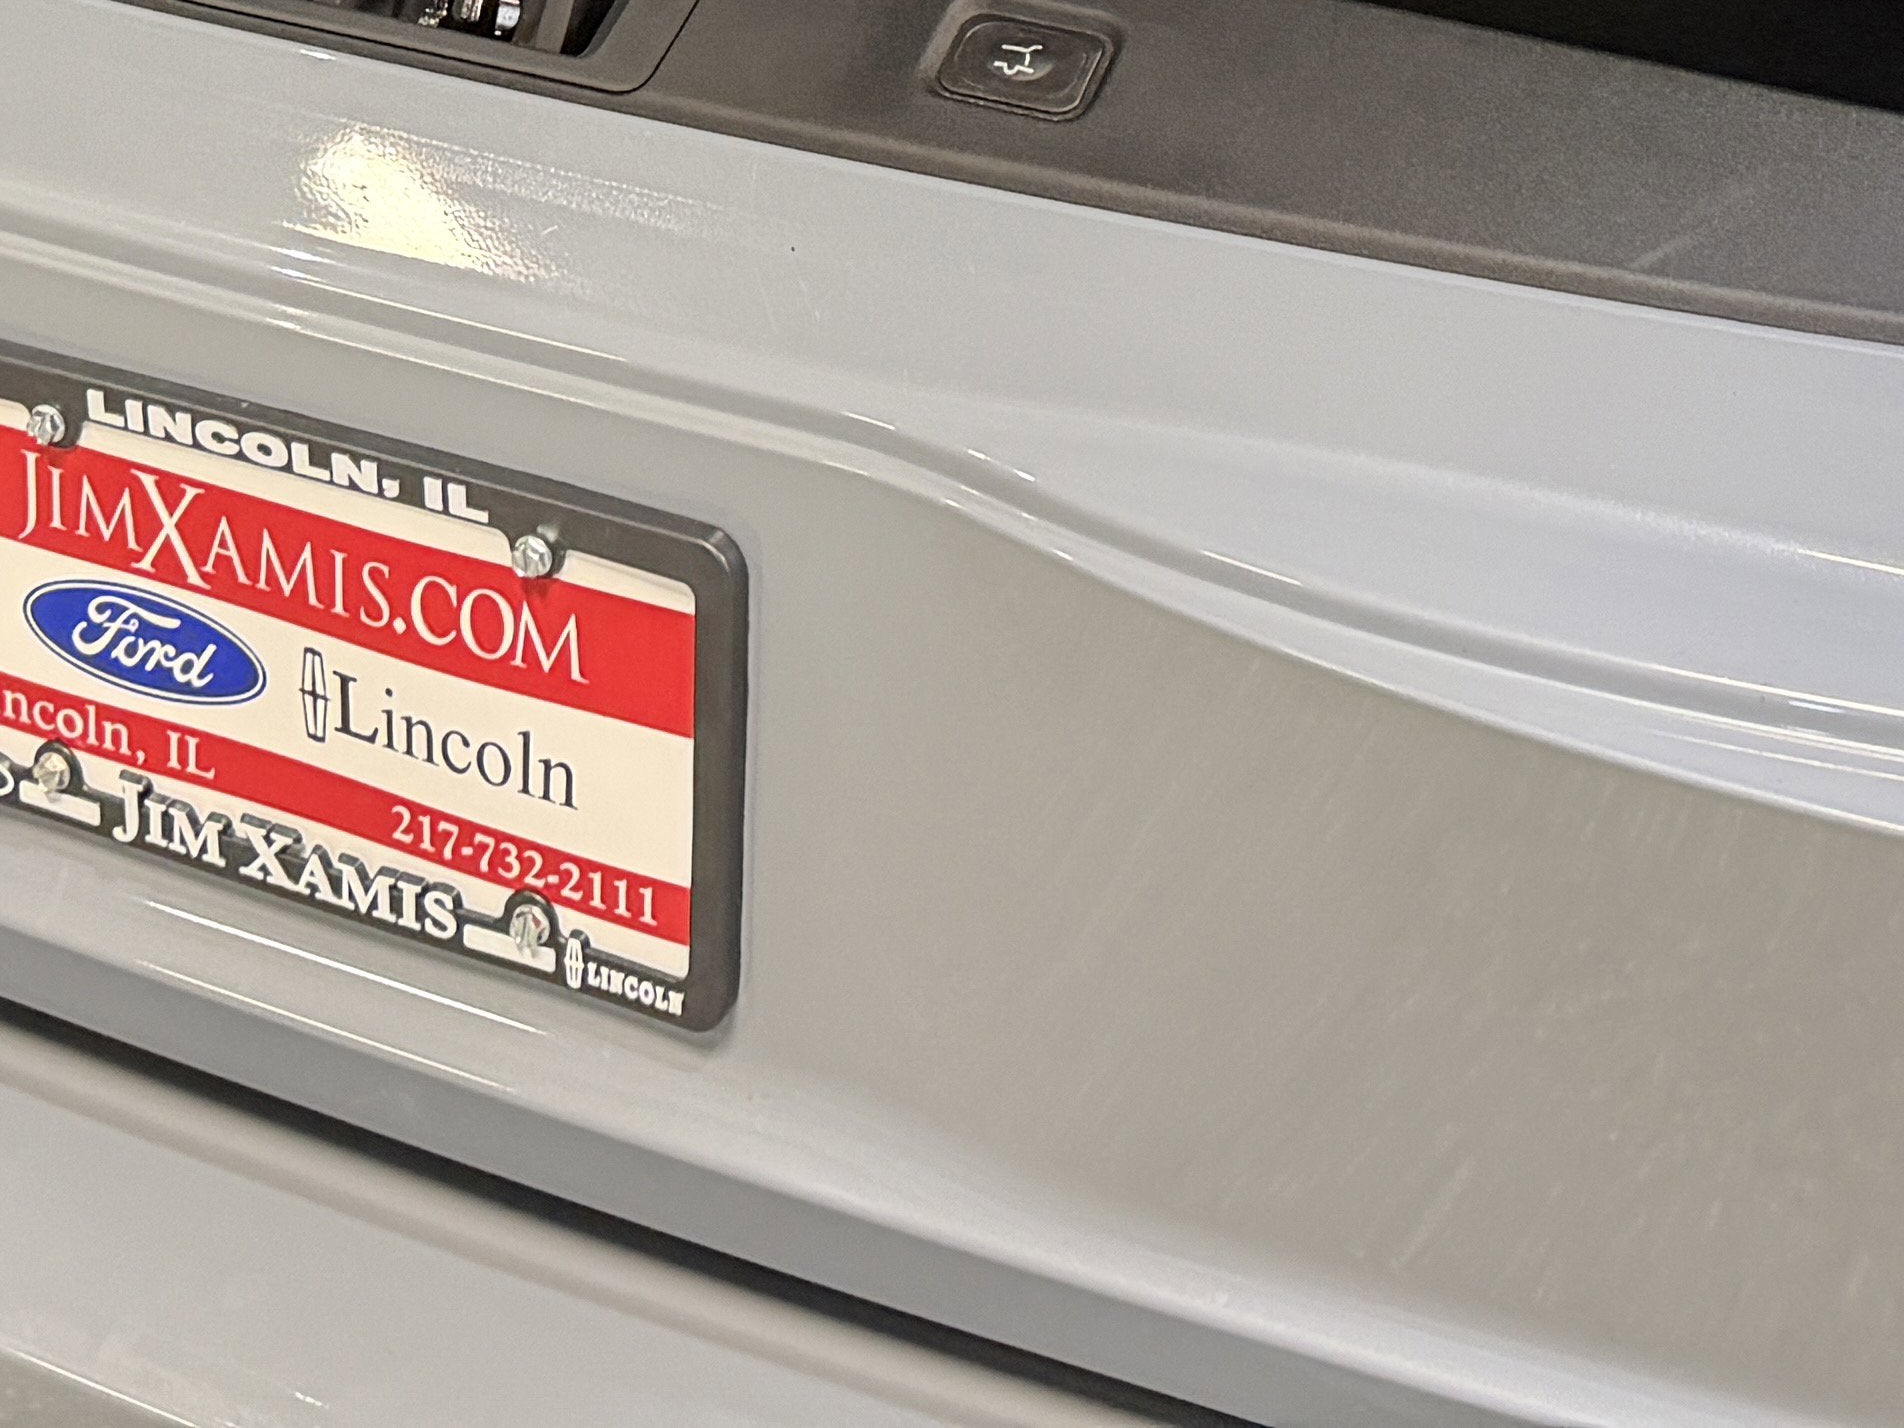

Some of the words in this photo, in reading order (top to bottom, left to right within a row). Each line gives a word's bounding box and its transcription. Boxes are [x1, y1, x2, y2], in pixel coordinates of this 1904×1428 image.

[86, 389, 400, 498] LINCOLN,
[423, 476, 490, 524] IL
[71, 594, 215, 689] Ford
[166, 729, 216, 780] IL
[332, 670, 578, 811] Lincoln
[112, 773, 227, 868] JIM
[239, 818, 459, 941] XAMIS
[391, 804, 658, 927] 217-732-2111
[586, 961, 686, 1018] LINCOLN
